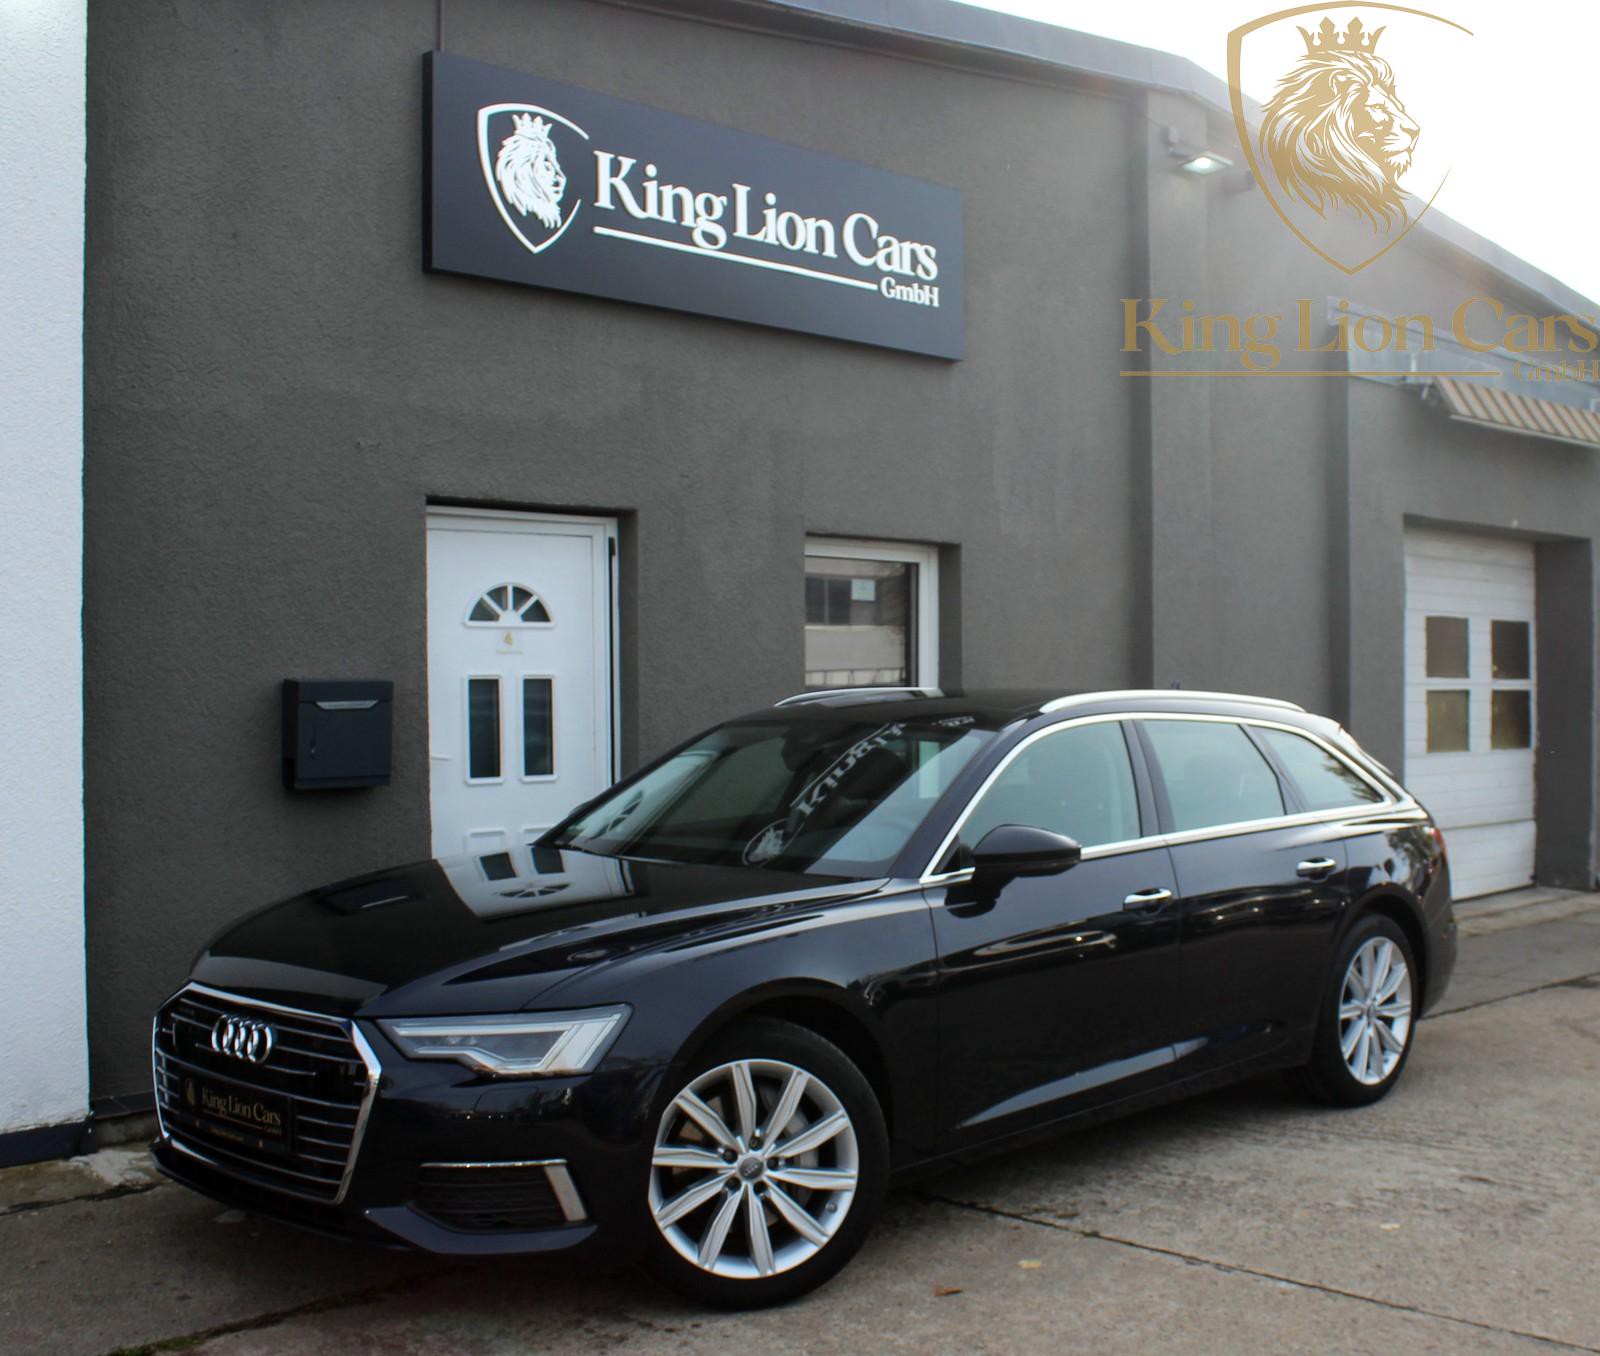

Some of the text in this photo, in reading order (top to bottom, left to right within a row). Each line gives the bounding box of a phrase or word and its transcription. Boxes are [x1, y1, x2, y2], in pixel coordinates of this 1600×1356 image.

[594, 150, 938, 281] King Lion Cars
[880, 277, 940, 308] GmbH
[202, 1087, 281, 1127] King Lion Cars
